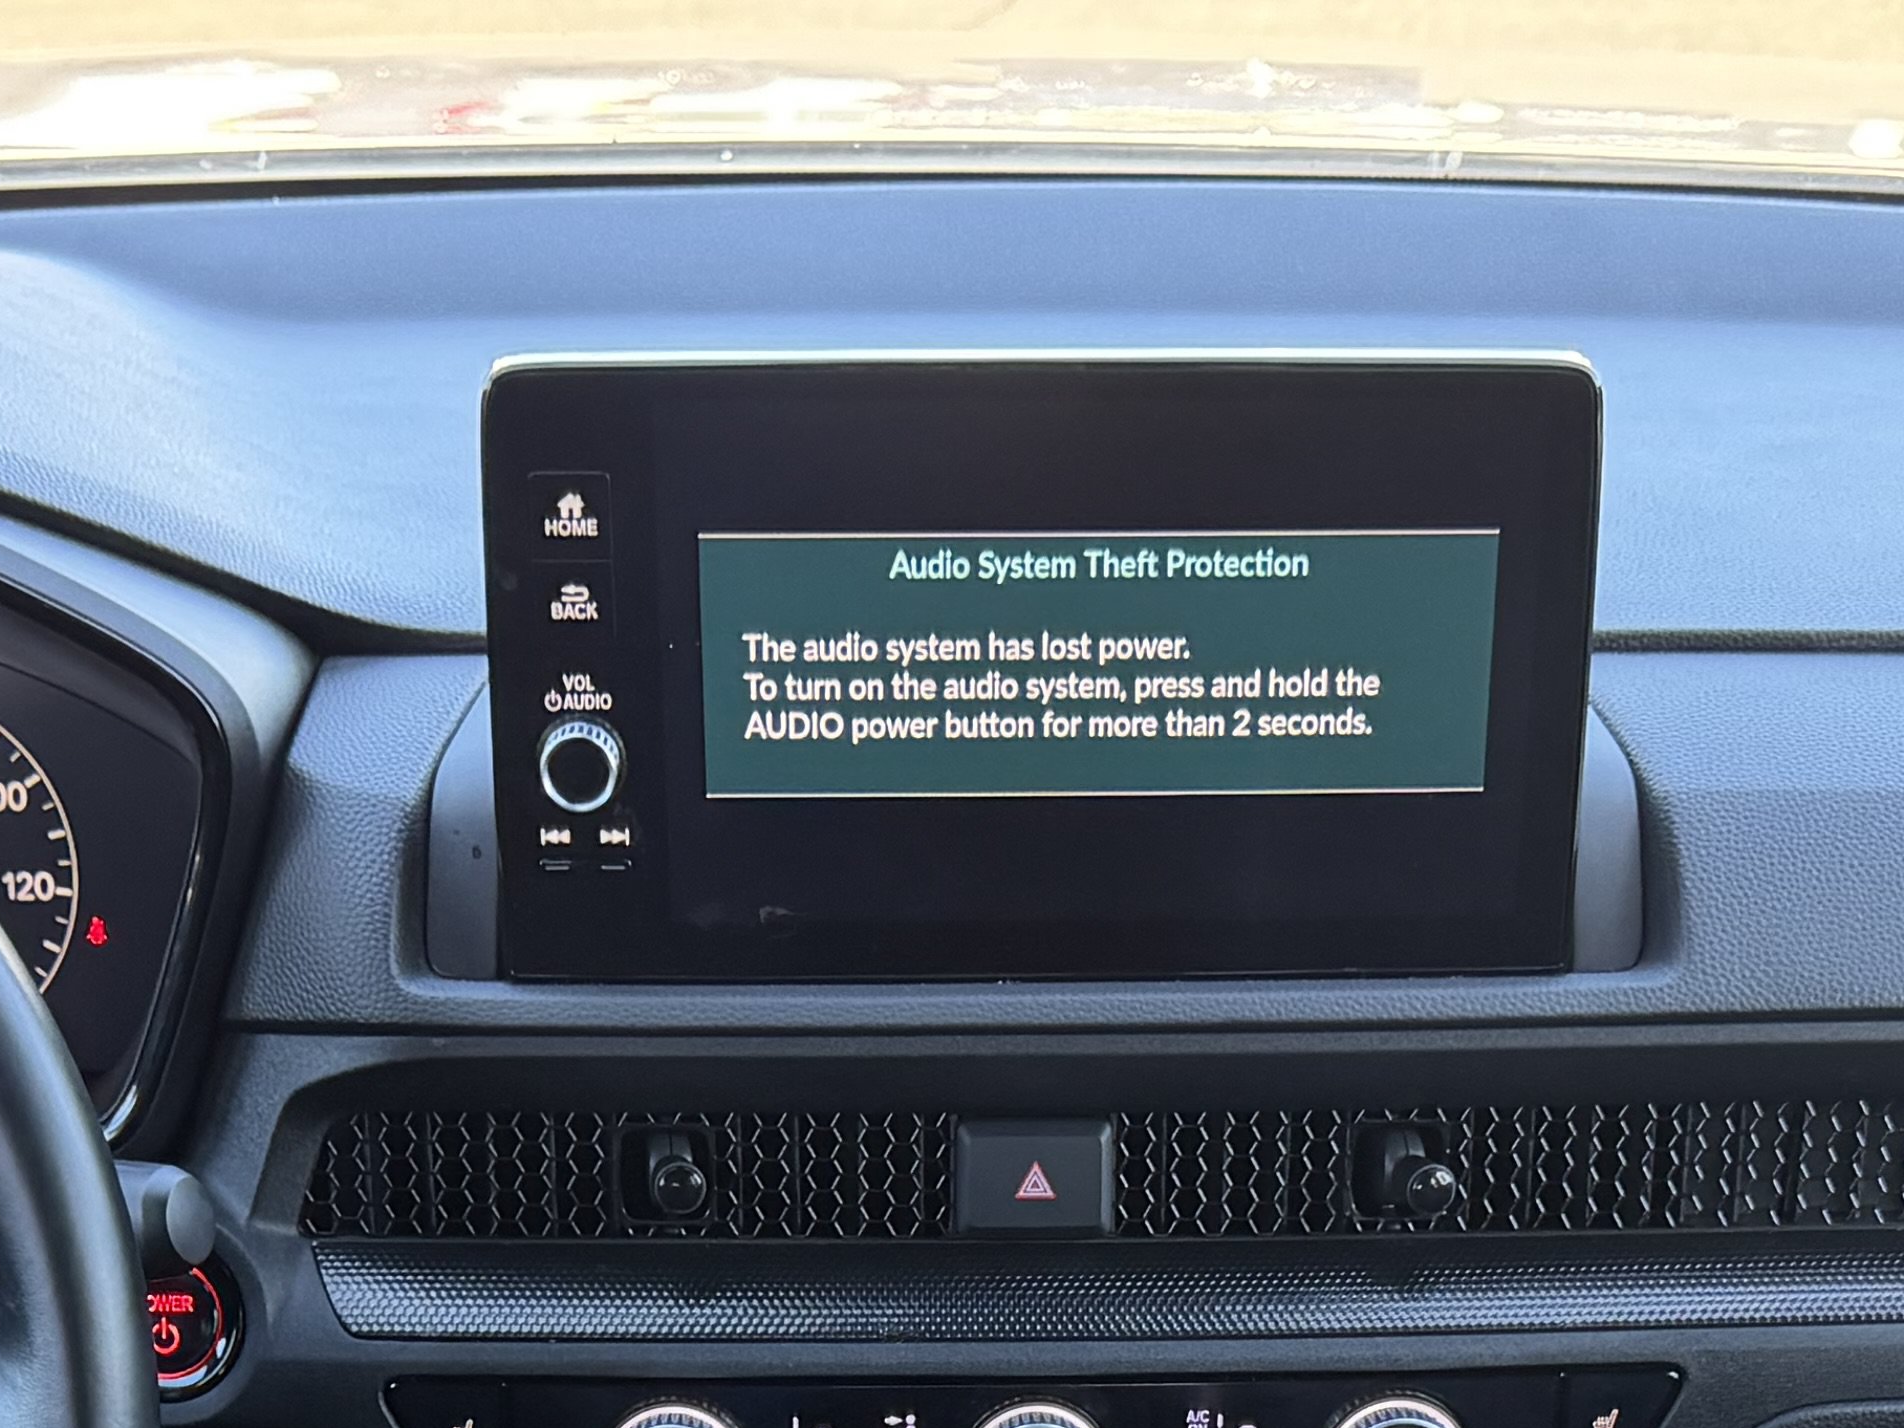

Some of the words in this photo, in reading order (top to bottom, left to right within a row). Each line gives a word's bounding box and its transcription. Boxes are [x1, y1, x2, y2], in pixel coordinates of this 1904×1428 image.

[544, 518, 599, 537] HOME
[889, 548, 970, 579] Audio
[978, 548, 1077, 584] System
[1083, 547, 1158, 579] Theft
[1167, 546, 1309, 578] Protection
[551, 602, 599, 621] BACK
[742, 631, 796, 662] The
[803, 631, 879, 662] audio
[886, 634, 981, 667] system
[988, 630, 1035, 661] has
[1041, 630, 1092, 661] lost
[1100, 636, 1190, 665] power.
[562, 673, 596, 692] VOL
[743, 672, 778, 701] To
[784, 672, 841, 701] turn
[849, 678, 884, 701] on
[892, 670, 937, 700] the
[944, 670, 1019, 700] audio
[1026, 671, 1127, 704] system,
[1135, 674, 1205, 704] press
[1211, 667, 1261, 698] and
[1268, 667, 1328, 697] hold
[1335, 667, 1381, 697] the
[563, 692, 613, 711] AUDIO
[744, 710, 845, 740] AUDIO
[852, 713, 939, 745] power
[945, 708, 1034, 739] button
[1041, 708, 1083, 739] for
[1088, 713, 1158, 738] more
[1165, 707, 1226, 737] than
[1231, 707, 1252, 737] 2
[1257, 706, 1373, 736] seconds.
[1, 870, 56, 904] 120
[146, 1293, 194, 1313] OWER
[1185, 1409, 1210, 1424] A/C
